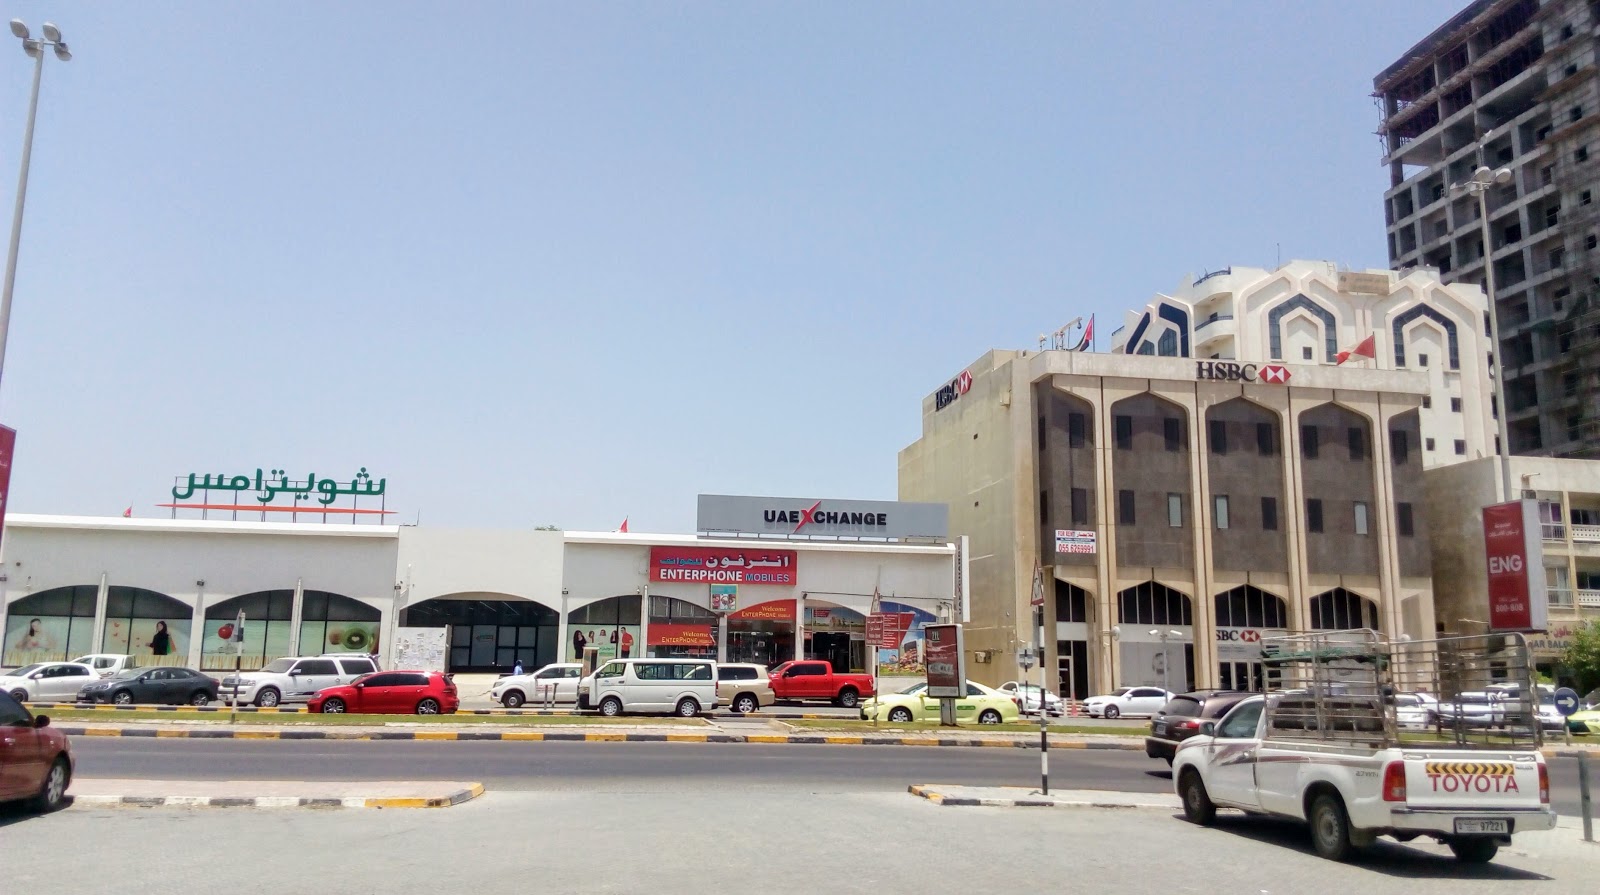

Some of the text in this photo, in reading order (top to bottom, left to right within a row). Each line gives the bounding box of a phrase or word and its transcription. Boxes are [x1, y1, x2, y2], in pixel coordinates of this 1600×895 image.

[1196, 361, 1257, 382] HSBC
[172, 467, 386, 504] شويترامس
[1489, 555, 1523, 574] ENG
[660, 569, 789, 582] ENTERPHONE MOBILES
[1216, 630, 1239, 641] SBC
[1428, 774, 1519, 793] TOYOTA
